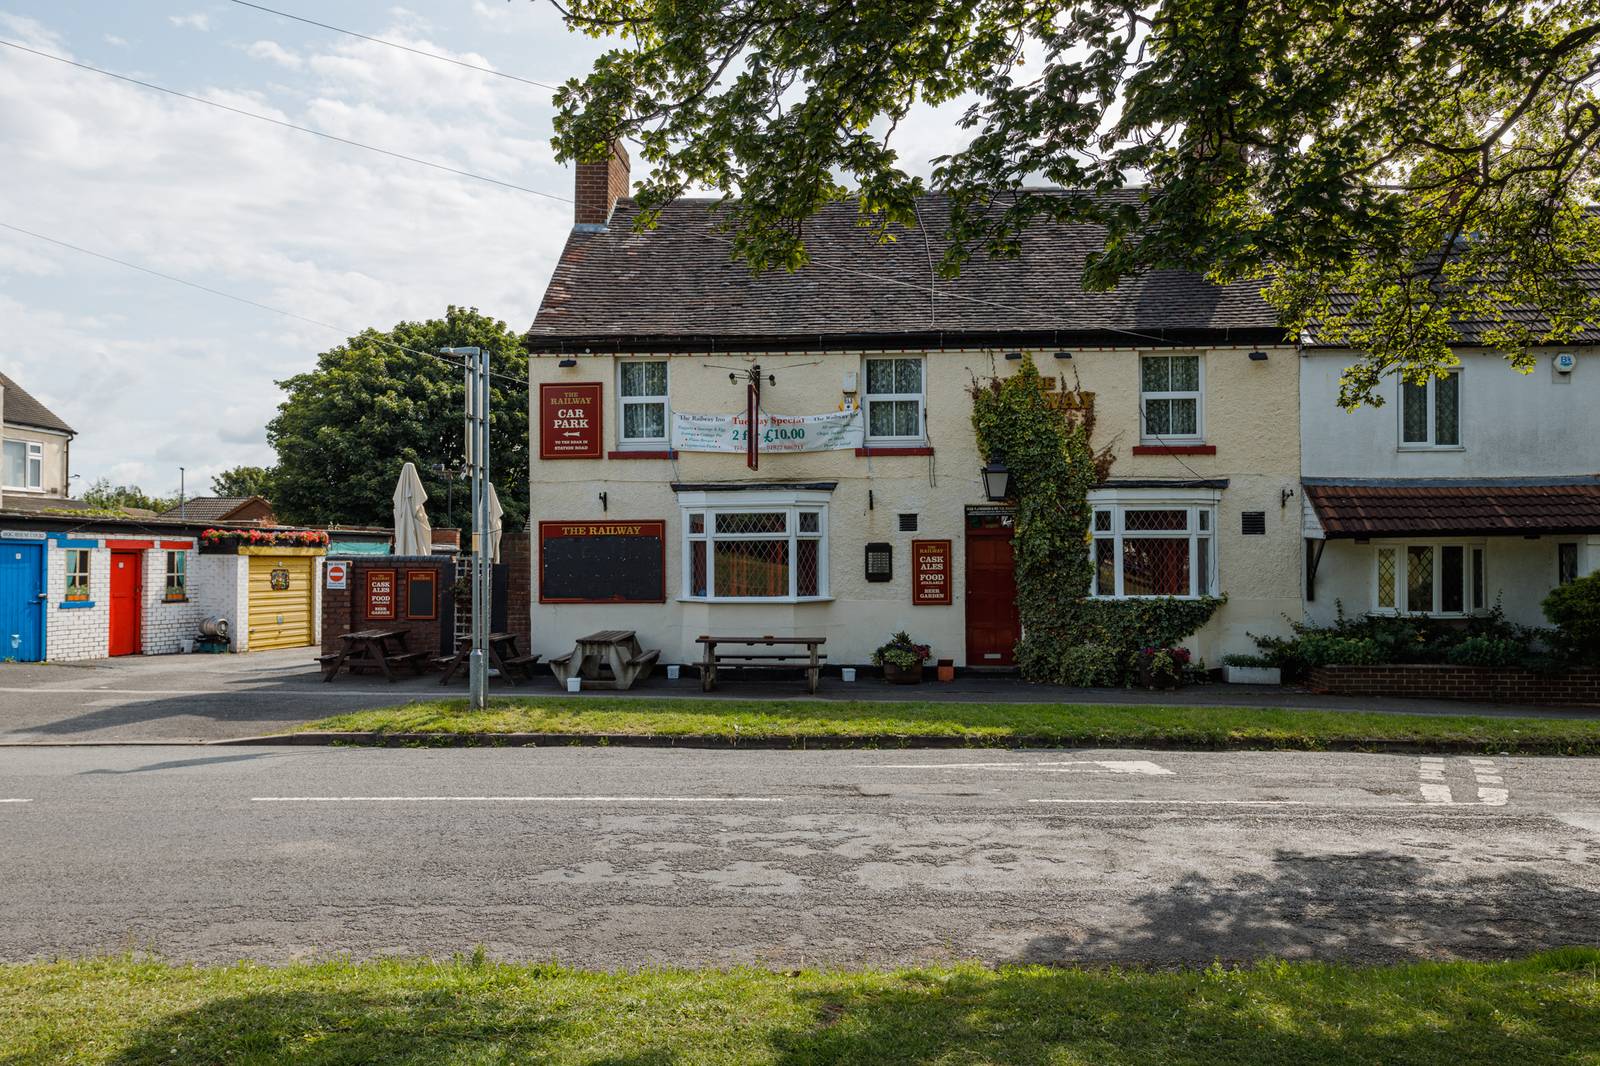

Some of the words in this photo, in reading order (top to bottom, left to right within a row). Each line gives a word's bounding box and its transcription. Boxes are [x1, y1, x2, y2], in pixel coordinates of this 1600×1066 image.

[558, 409, 584, 418] CAR
[553, 420, 589, 429] PARK
[771, 416, 805, 426] Special
[732, 429, 739, 440] 2
[764, 428, 805, 442] £10.00
[562, 526, 586, 535] THE
[589, 526, 641, 535] RAILWAY
